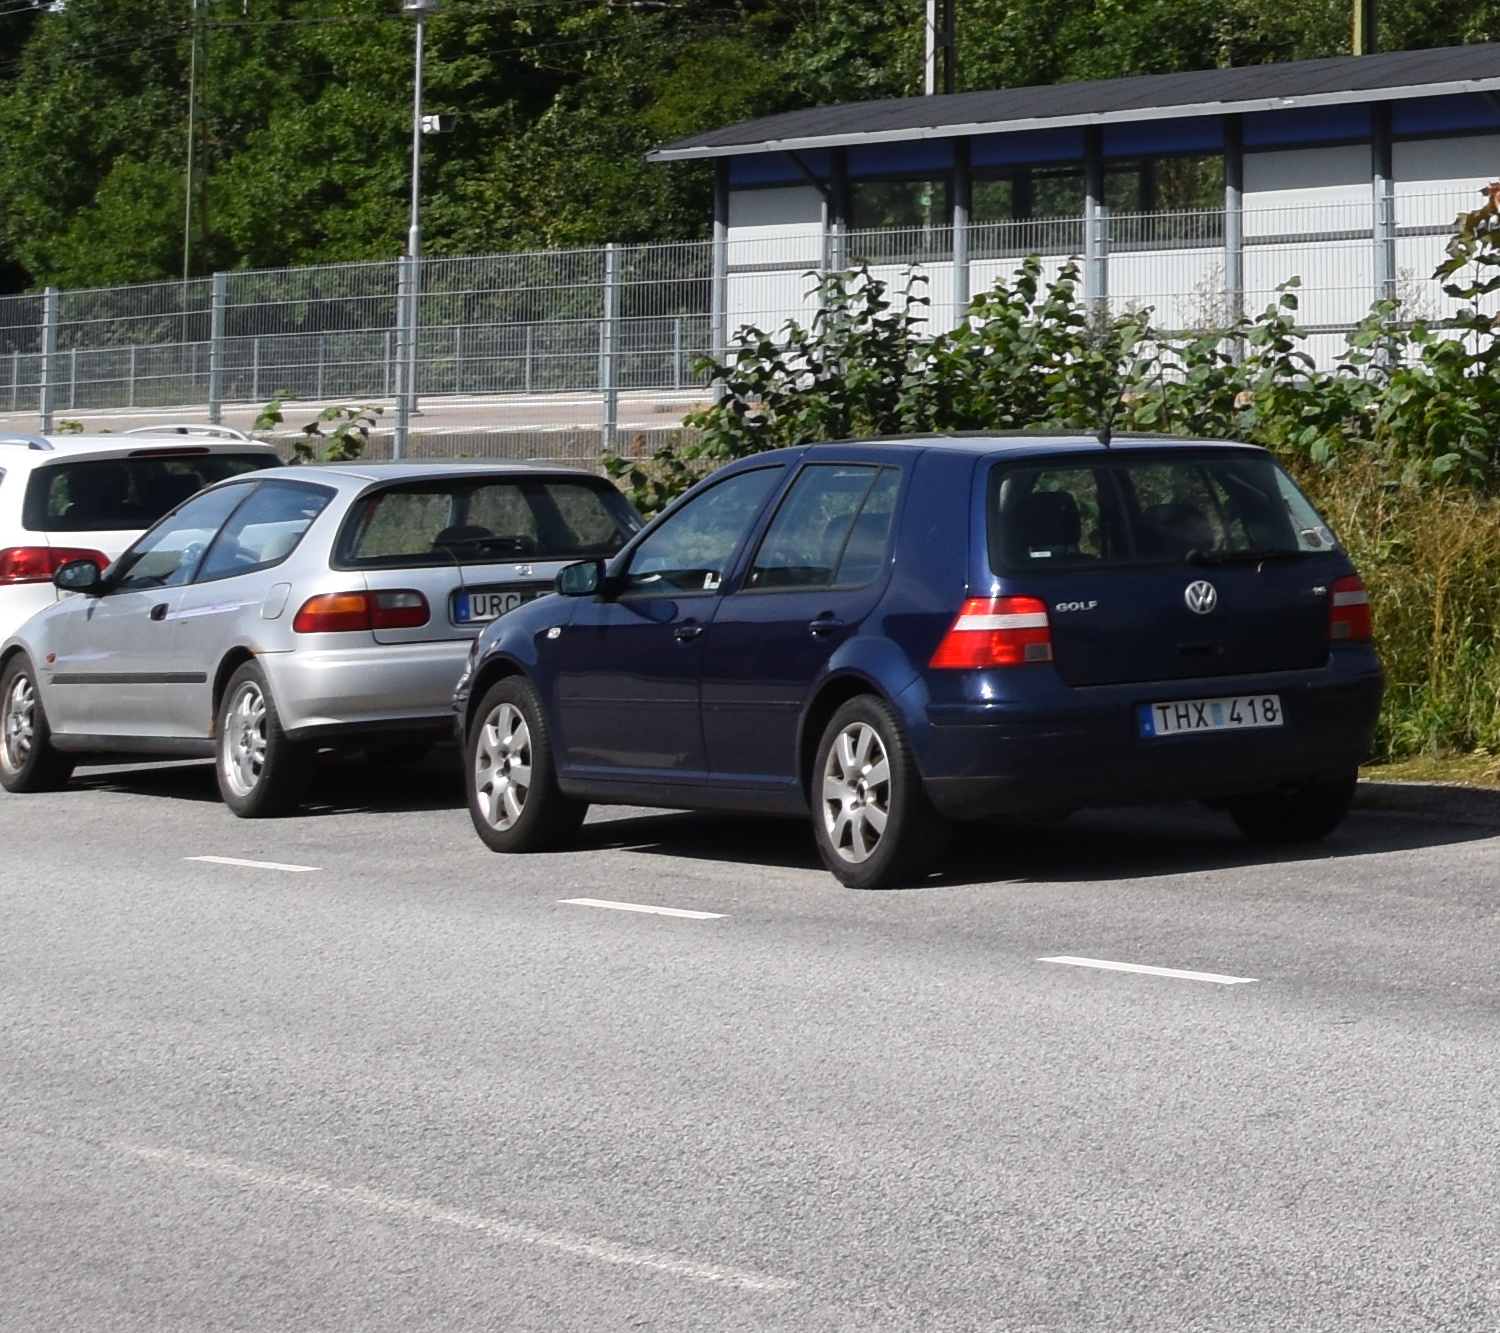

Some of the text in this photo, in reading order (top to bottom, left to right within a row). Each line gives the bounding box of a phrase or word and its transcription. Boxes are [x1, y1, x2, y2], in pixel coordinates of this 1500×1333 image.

[1055, 600, 1098, 613] GOLF
[1156, 698, 1278, 731] THX 418
